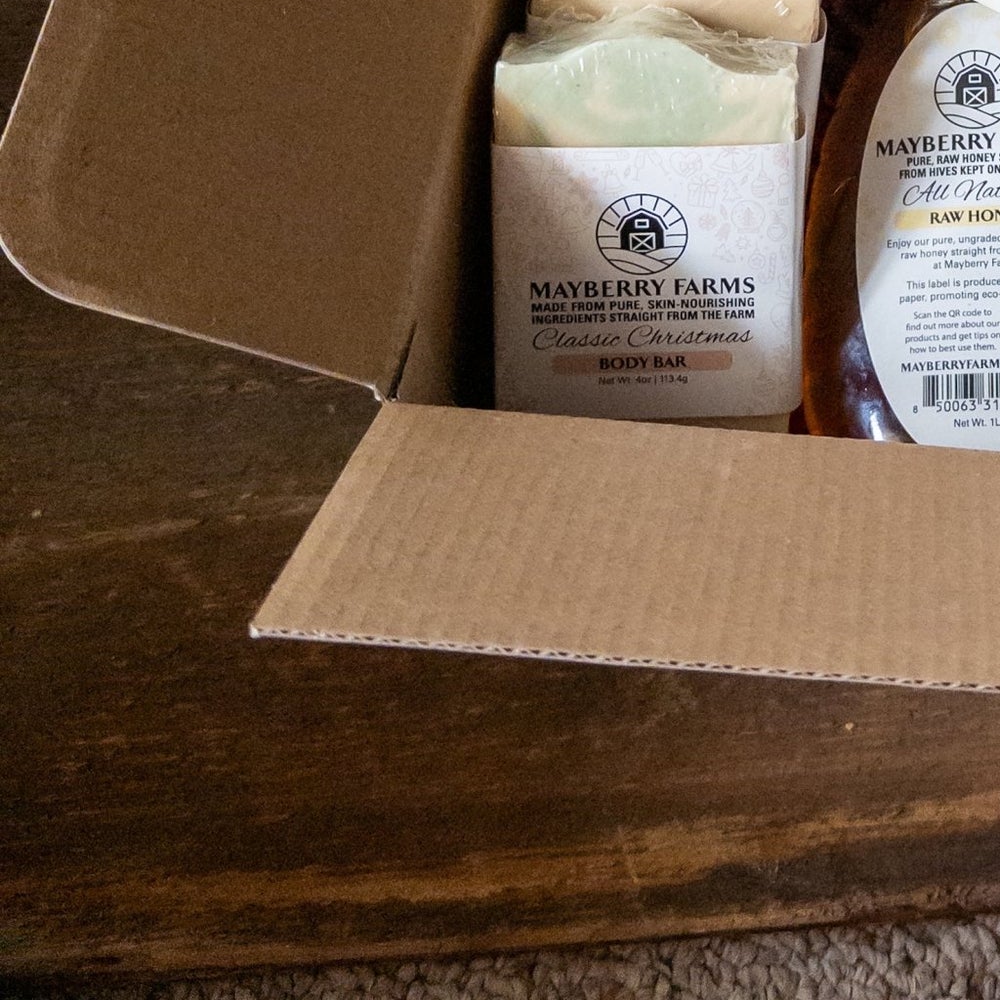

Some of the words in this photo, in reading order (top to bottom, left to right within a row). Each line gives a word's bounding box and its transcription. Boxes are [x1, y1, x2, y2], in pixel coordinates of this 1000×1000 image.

[877, 132, 997, 158] MAYBERRY
[907, 156, 934, 167] PURE,
[937, 155, 959, 164] RAW
[962, 153, 995, 162] HONEY
[899, 168, 926, 179] FROM
[929, 167, 958, 177] HIVES
[961, 165, 983, 175] KEPT
[988, 165, 1000, 174] ON
[903, 180, 949, 206] All
[930, 211, 964, 224] RAW
[887, 238, 911, 249] Enjoy
[914, 237, 929, 246] our
[932, 236, 956, 246] pure,
[901, 250, 917, 259] raw
[920, 248, 948, 258] honey
[951, 246, 987, 256] straight
[933, 261, 942, 269] at
[944, 260, 989, 270] Mayberry
[530, 279, 666, 299] MAYBERRY
[674, 276, 755, 295] FARMS
[907, 280, 926, 290] This
[928, 279, 950, 288] label
[953, 278, 961, 287] is
[899, 294, 927, 305] paper,
[930, 291, 979, 302] promoting
[531, 301, 567, 312] MADE
[572, 301, 605, 311] FROM
[610, 300, 644, 311] PURE,
[648, 298, 755, 309] SKIN-NOURISHING
[532, 313, 606, 324] INGREDIENTS
[609, 312, 663, 322] STRAIGHT
[667, 311, 698, 320] FROM
[701, 310, 722, 319] THE
[724, 310, 755, 319] FARM
[914, 311, 932, 319] Scan
[934, 310, 946, 318] the
[906, 323, 921, 331] find
[923, 322, 936, 330] out
[961, 320, 985, 328] about
[533, 327, 621, 350] Classic
[627, 325, 752, 348] Christmas
[905, 334, 939, 344] products
[959, 333, 971, 341] get
[974, 332, 988, 340] tips
[910, 346, 927, 355] how
[973, 343, 997, 351] them.
[600, 356, 649, 370] BODY
[653, 355, 686, 368] BAR
[599, 377, 614, 385] Net
[913, 405, 918, 414] 8
[936, 400, 976, 412] 50063
[954, 419, 969, 427] Net
[972, 418, 987, 427] Wt.
